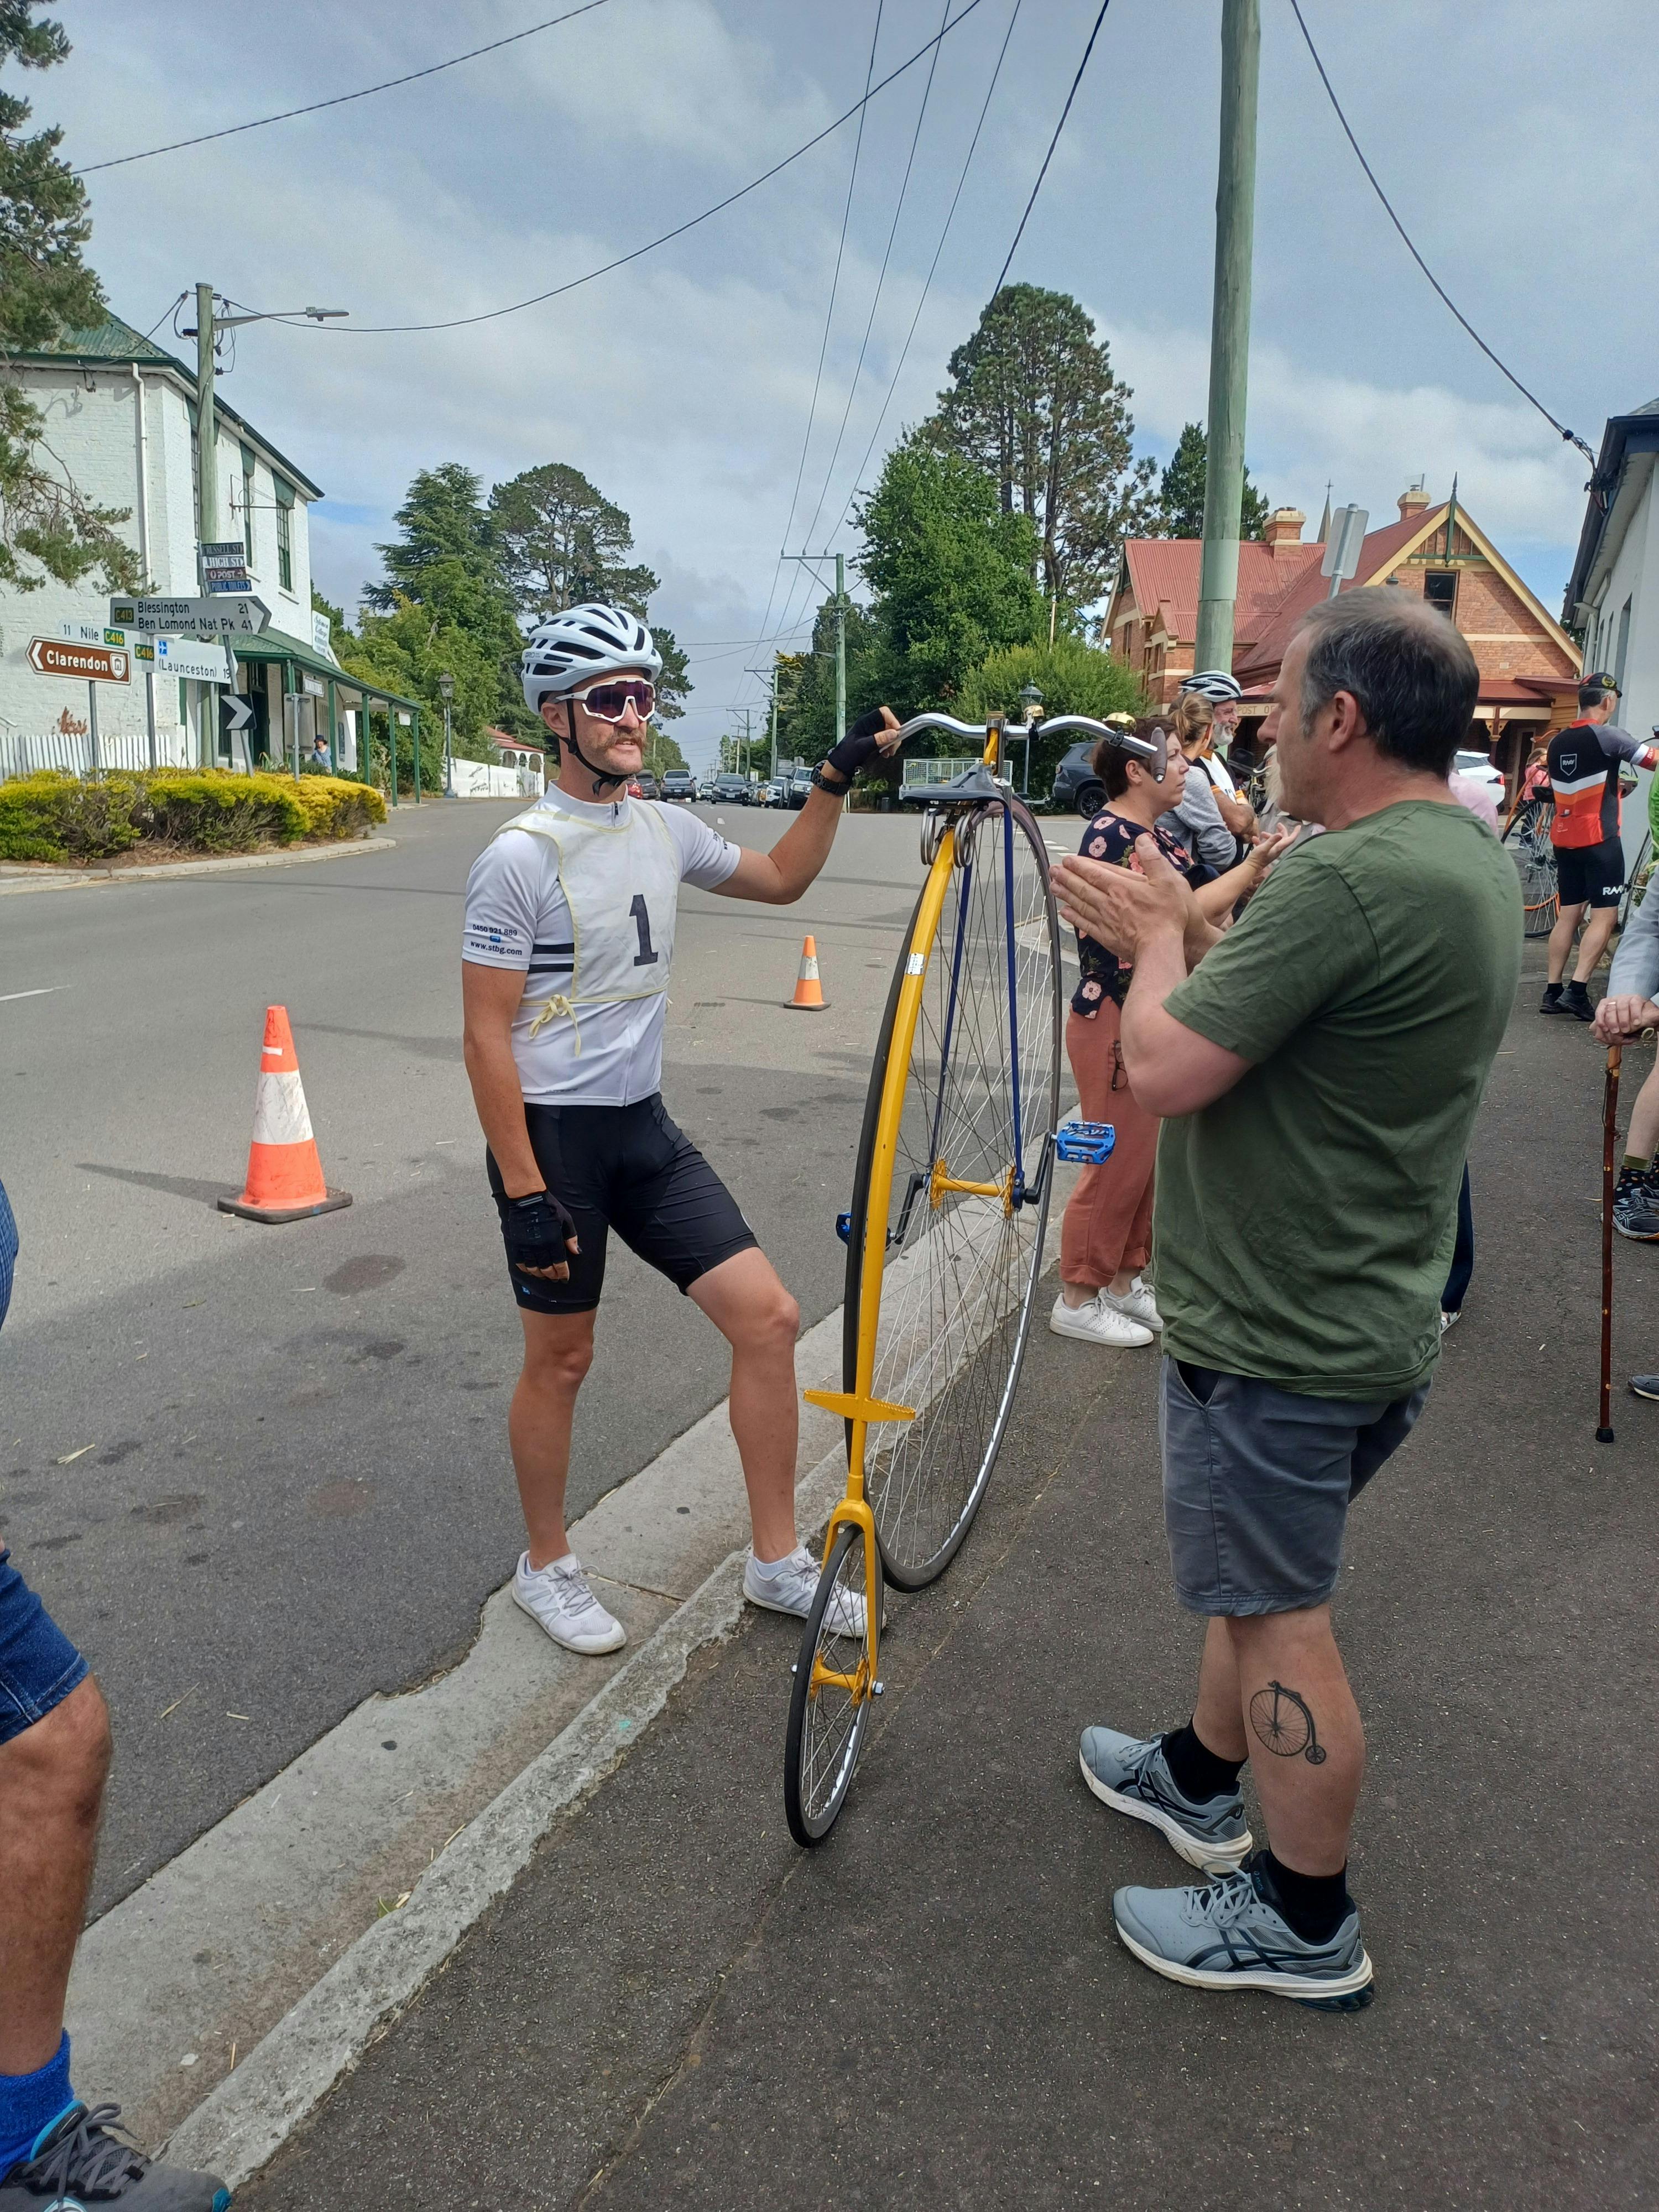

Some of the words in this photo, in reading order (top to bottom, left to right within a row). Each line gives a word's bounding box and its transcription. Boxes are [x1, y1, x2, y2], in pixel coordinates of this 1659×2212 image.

[217, 570, 236, 579] POST
[115, 610, 133, 620] C413
[138, 602, 190, 617] Blessington
[238, 603, 249, 614] 21
[138, 618, 156, 629] Ben
[159, 618, 196, 630] Lomond
[200, 618, 218, 630] Nat
[222, 618, 235, 630] Pk
[241, 619, 253, 630] 41
[64, 624, 71, 635] 11
[80, 626, 99, 640] Nile
[105, 632, 124, 645] C416
[135, 646, 154, 659] C416
[46, 650, 108, 672] Clarendon
[158, 658, 217, 678] (Launceston)
[1237, 706, 1257, 714] POST
[473, 924, 488, 932] 0450
[629, 894, 659, 967] 1
[471, 941, 523, 956] www.stbg.com
